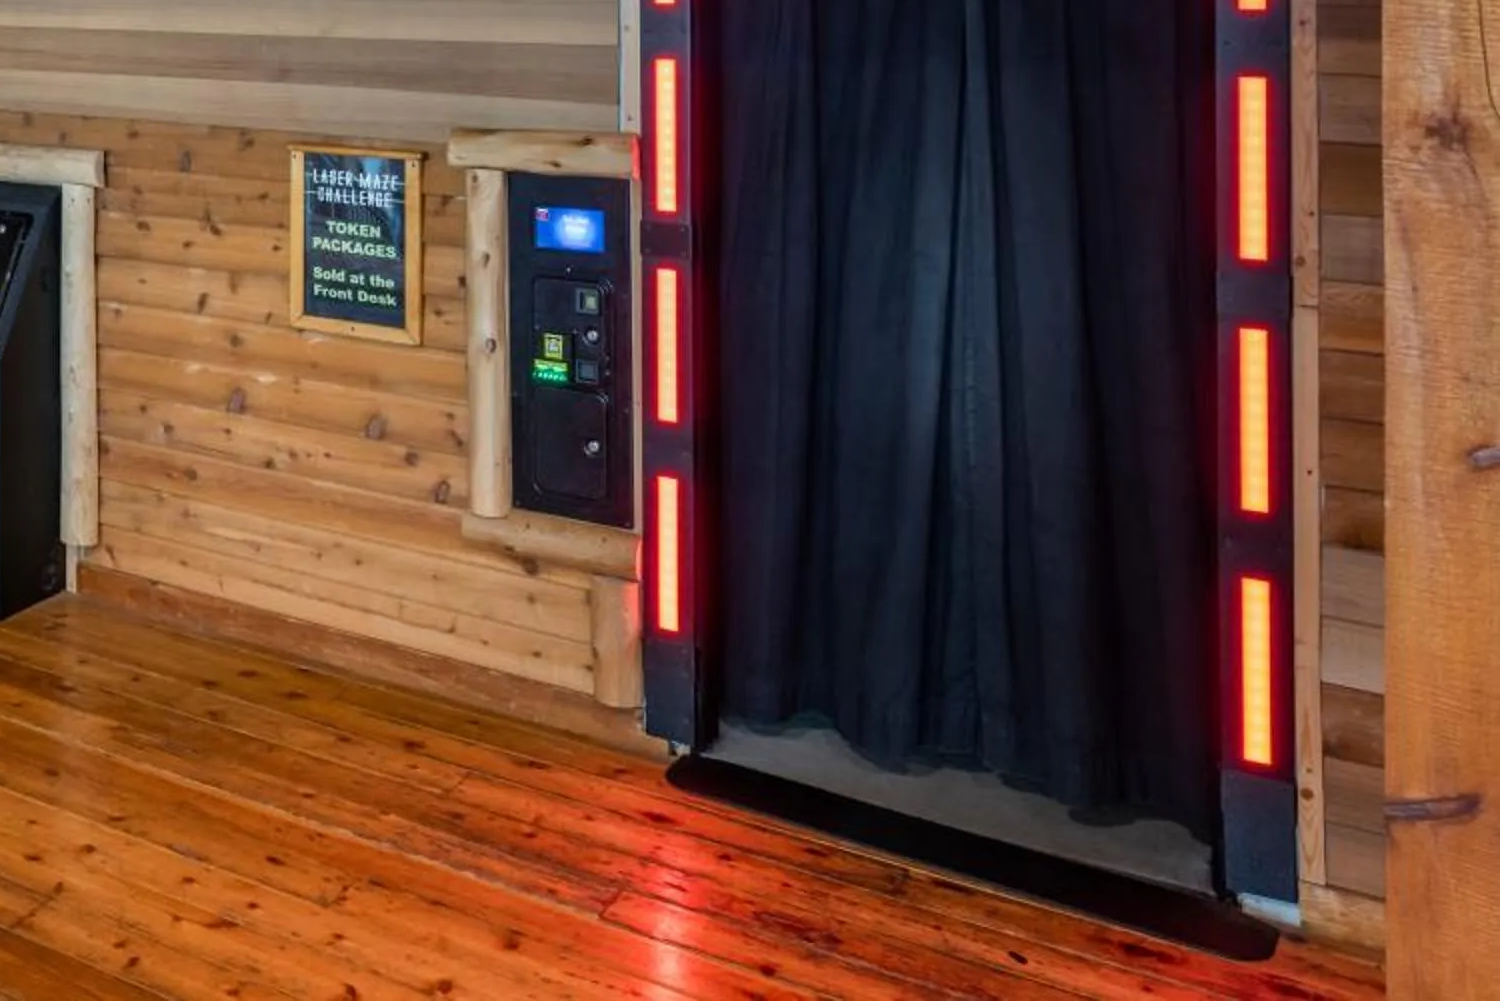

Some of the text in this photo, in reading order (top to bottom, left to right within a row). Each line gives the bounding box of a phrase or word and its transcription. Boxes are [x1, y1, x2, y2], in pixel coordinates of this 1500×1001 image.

[313, 168, 399, 191] LASER MAZE
[317, 186, 394, 208] CHALLENGE
[325, 220, 381, 239] TOKEN
[312, 237, 397, 258] PACKAGES
[313, 266, 395, 289] Sold at the
[313, 284, 397, 307] Front Desk
